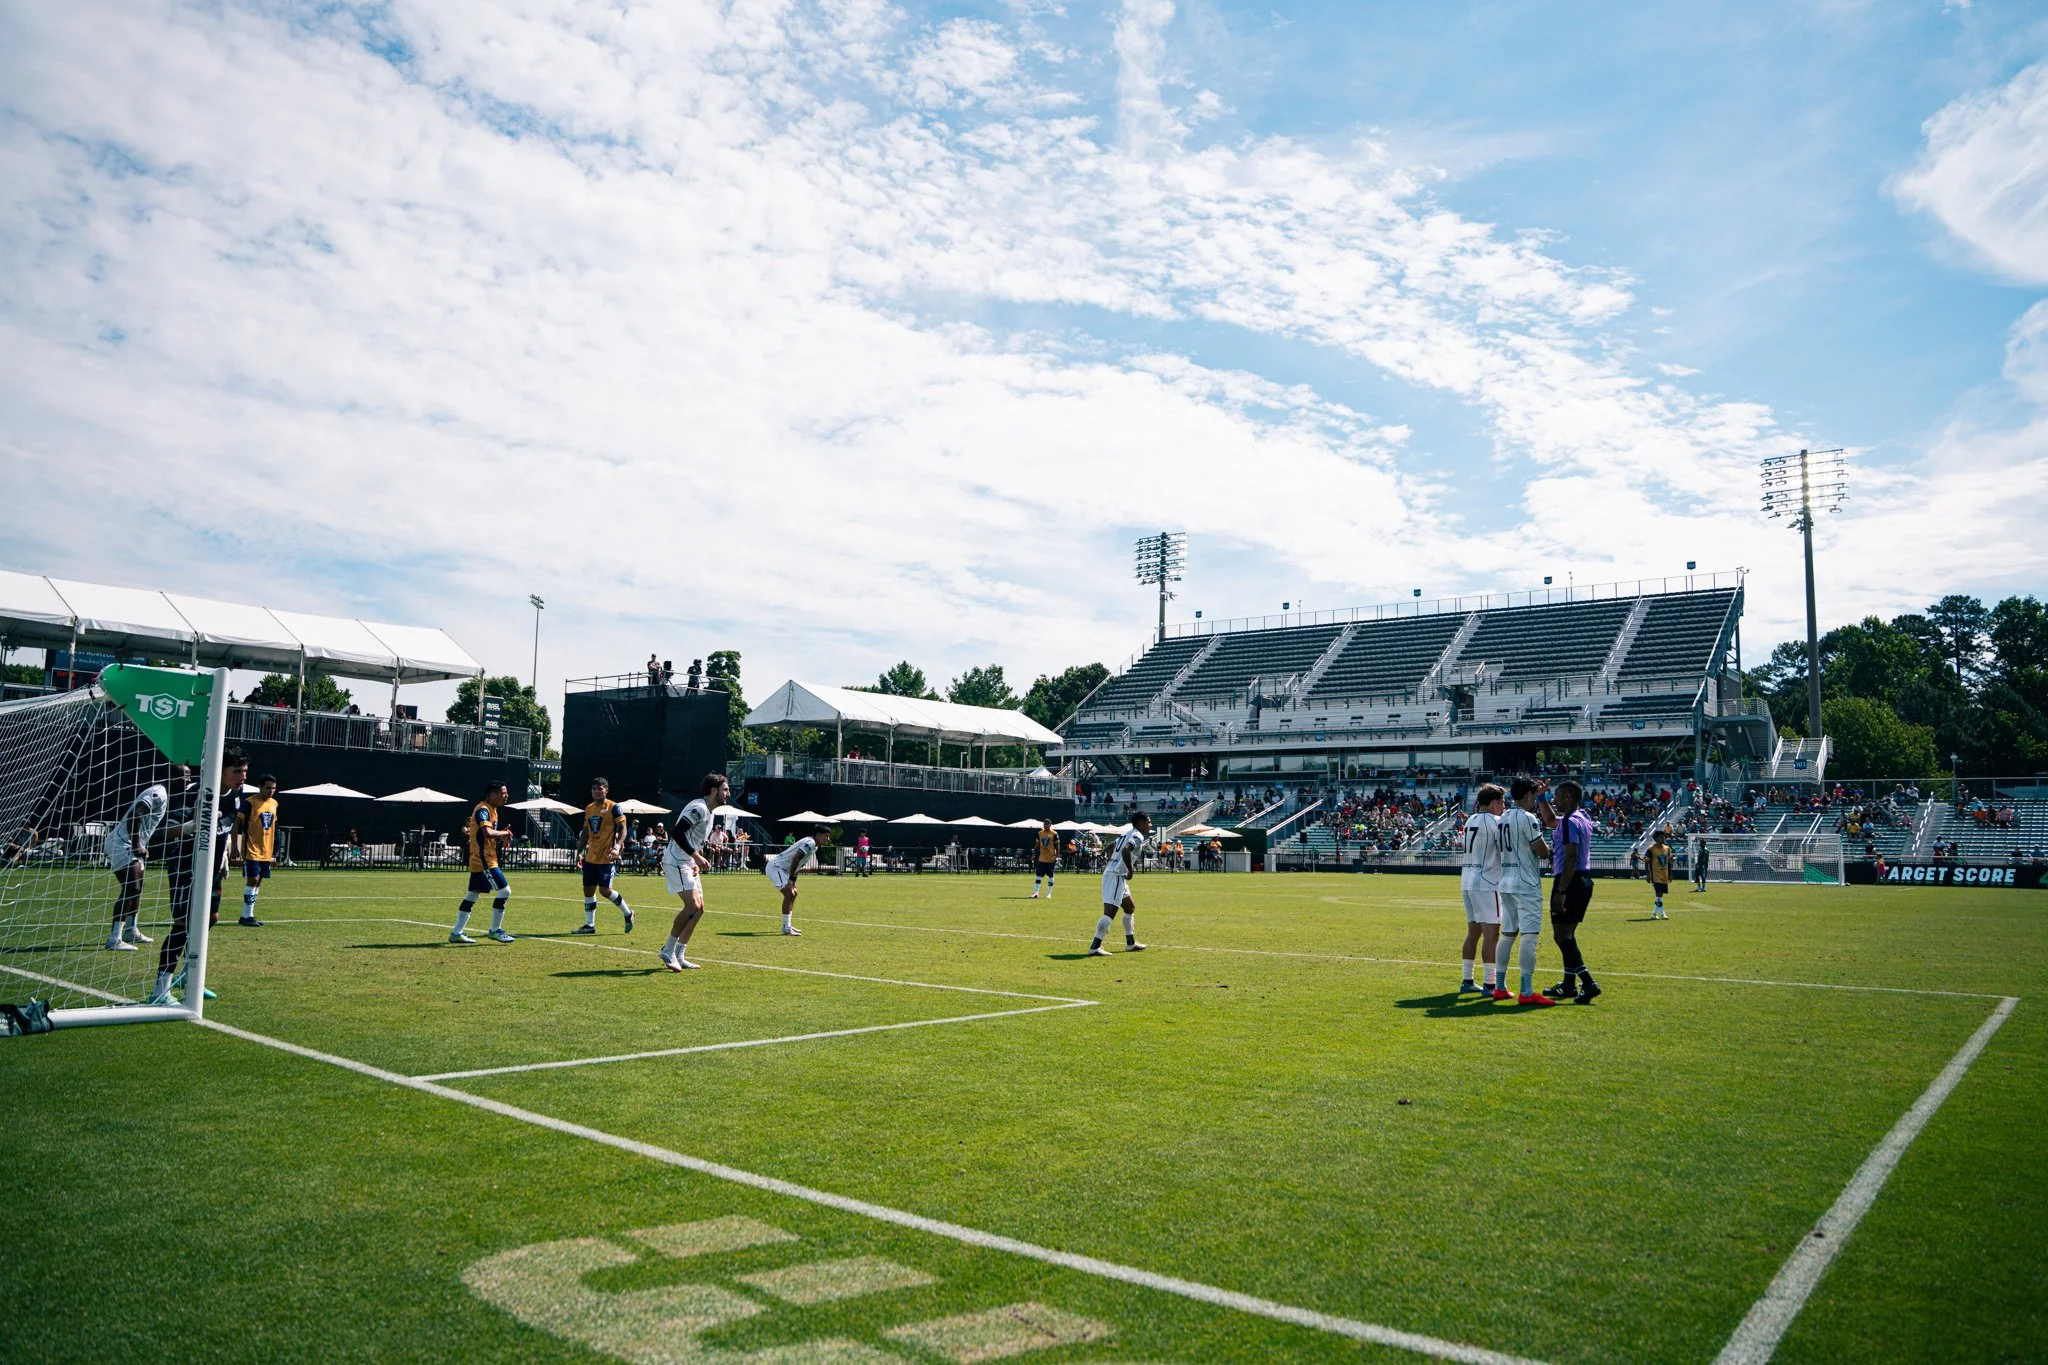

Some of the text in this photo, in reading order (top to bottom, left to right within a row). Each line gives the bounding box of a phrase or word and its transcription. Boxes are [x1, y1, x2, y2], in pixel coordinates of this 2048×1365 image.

[135, 693, 194, 719] TST
[1464, 826, 1479, 853] 17
[1498, 823, 1512, 852] 10
[1953, 867, 2017, 883] SCORE
